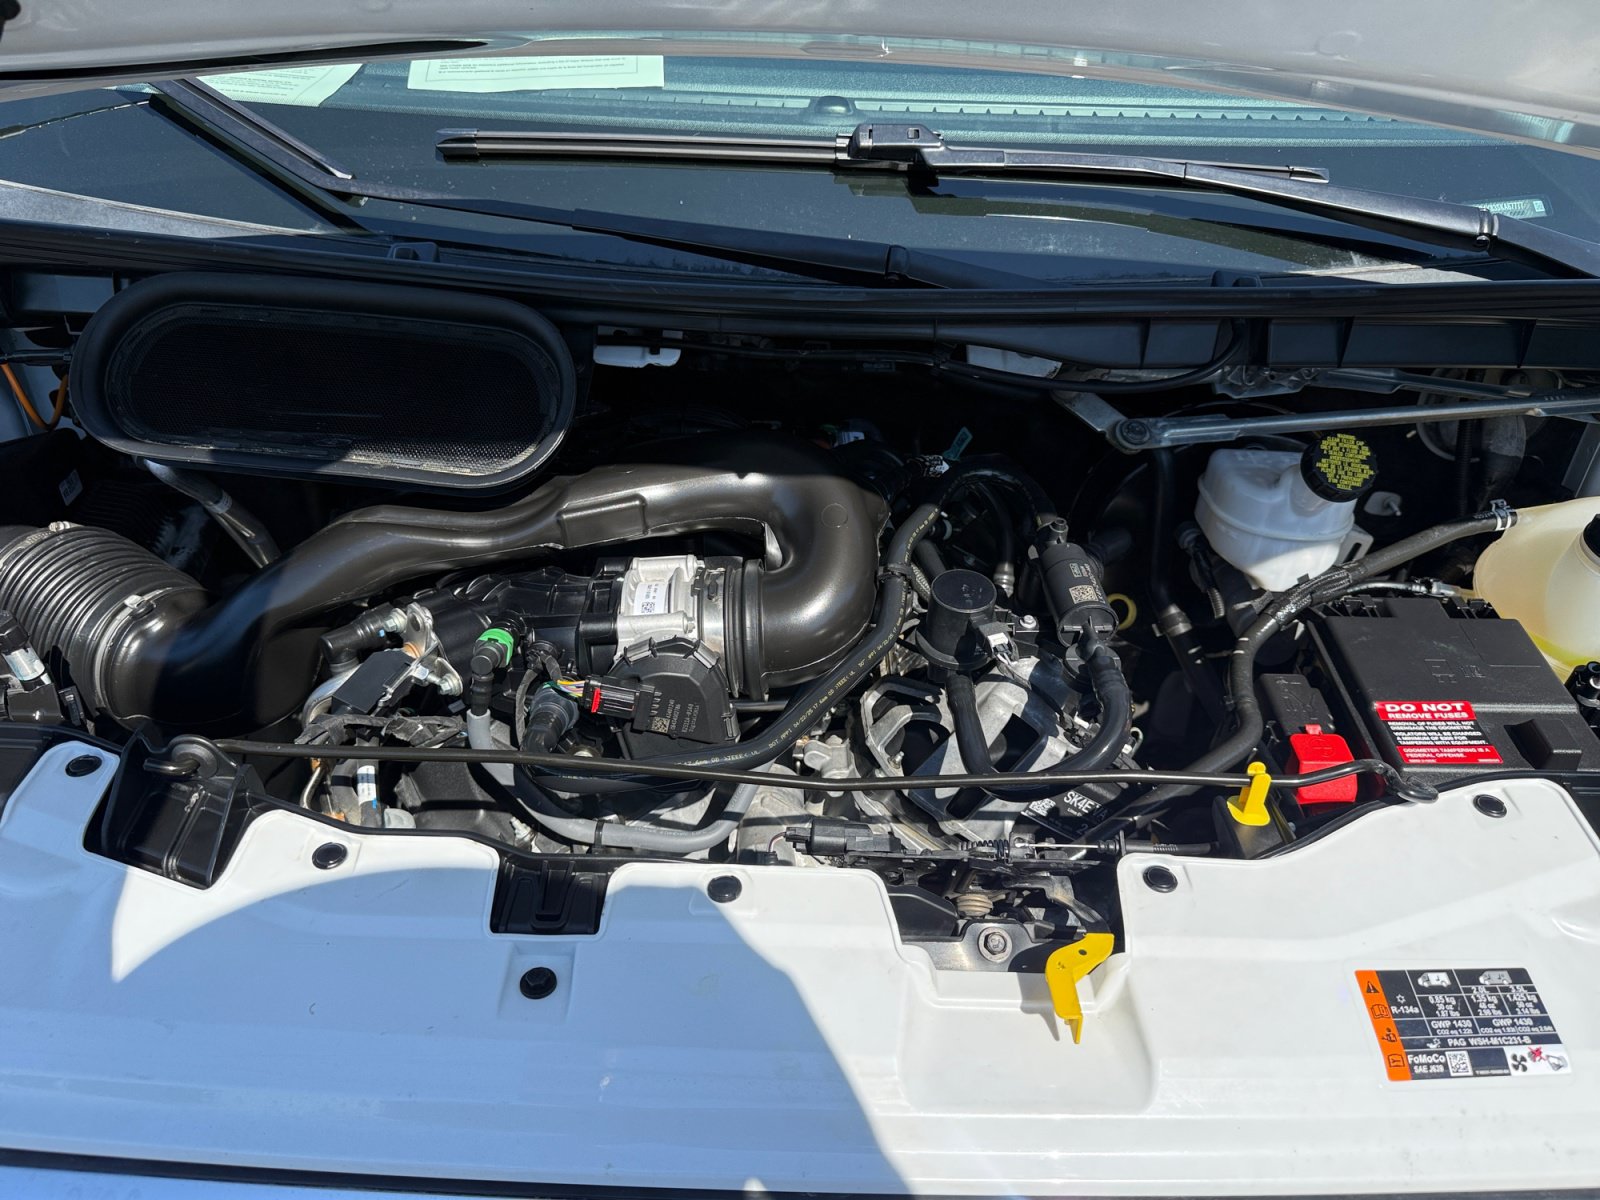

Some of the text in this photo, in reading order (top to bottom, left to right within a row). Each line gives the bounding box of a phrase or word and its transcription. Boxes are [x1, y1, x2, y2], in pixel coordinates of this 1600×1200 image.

[1385, 703, 1464, 712] DO NOT
[1390, 1005, 1420, 1014] R-134a
[1408, 1054, 1446, 1064] FoMoCo
[1414, 1065, 1428, 1073] SAE
